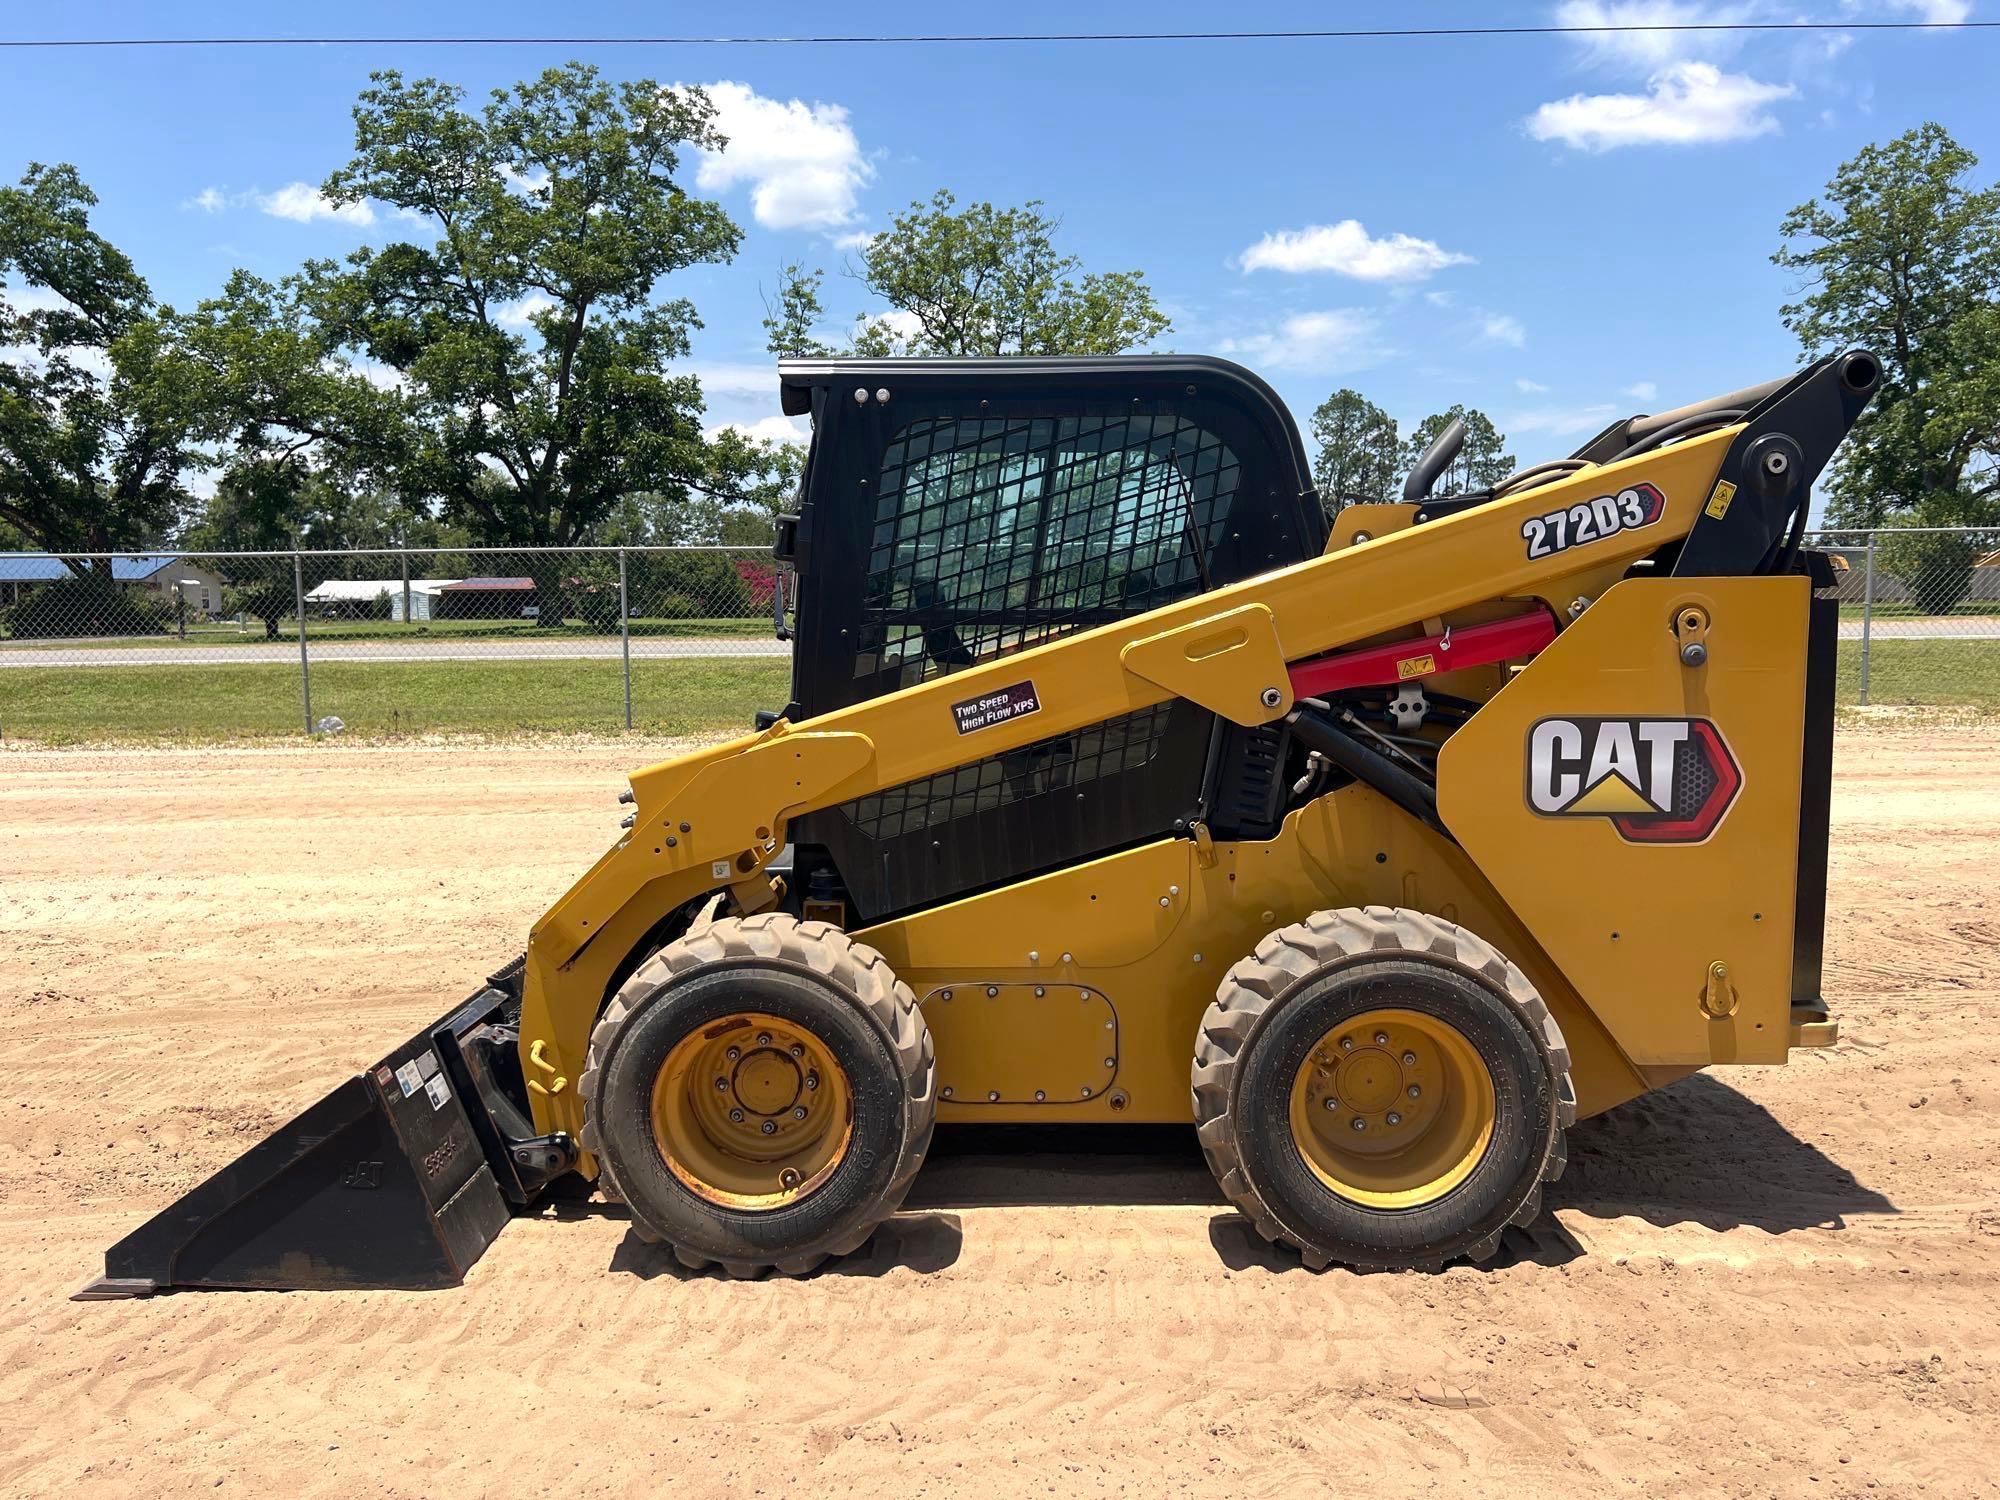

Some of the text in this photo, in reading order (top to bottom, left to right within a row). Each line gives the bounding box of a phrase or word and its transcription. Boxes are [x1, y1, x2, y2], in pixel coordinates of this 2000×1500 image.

[1523, 490, 1644, 557] 272D3
[1013, 698, 1035, 714] XPS
[1531, 720, 1689, 812] CAT
